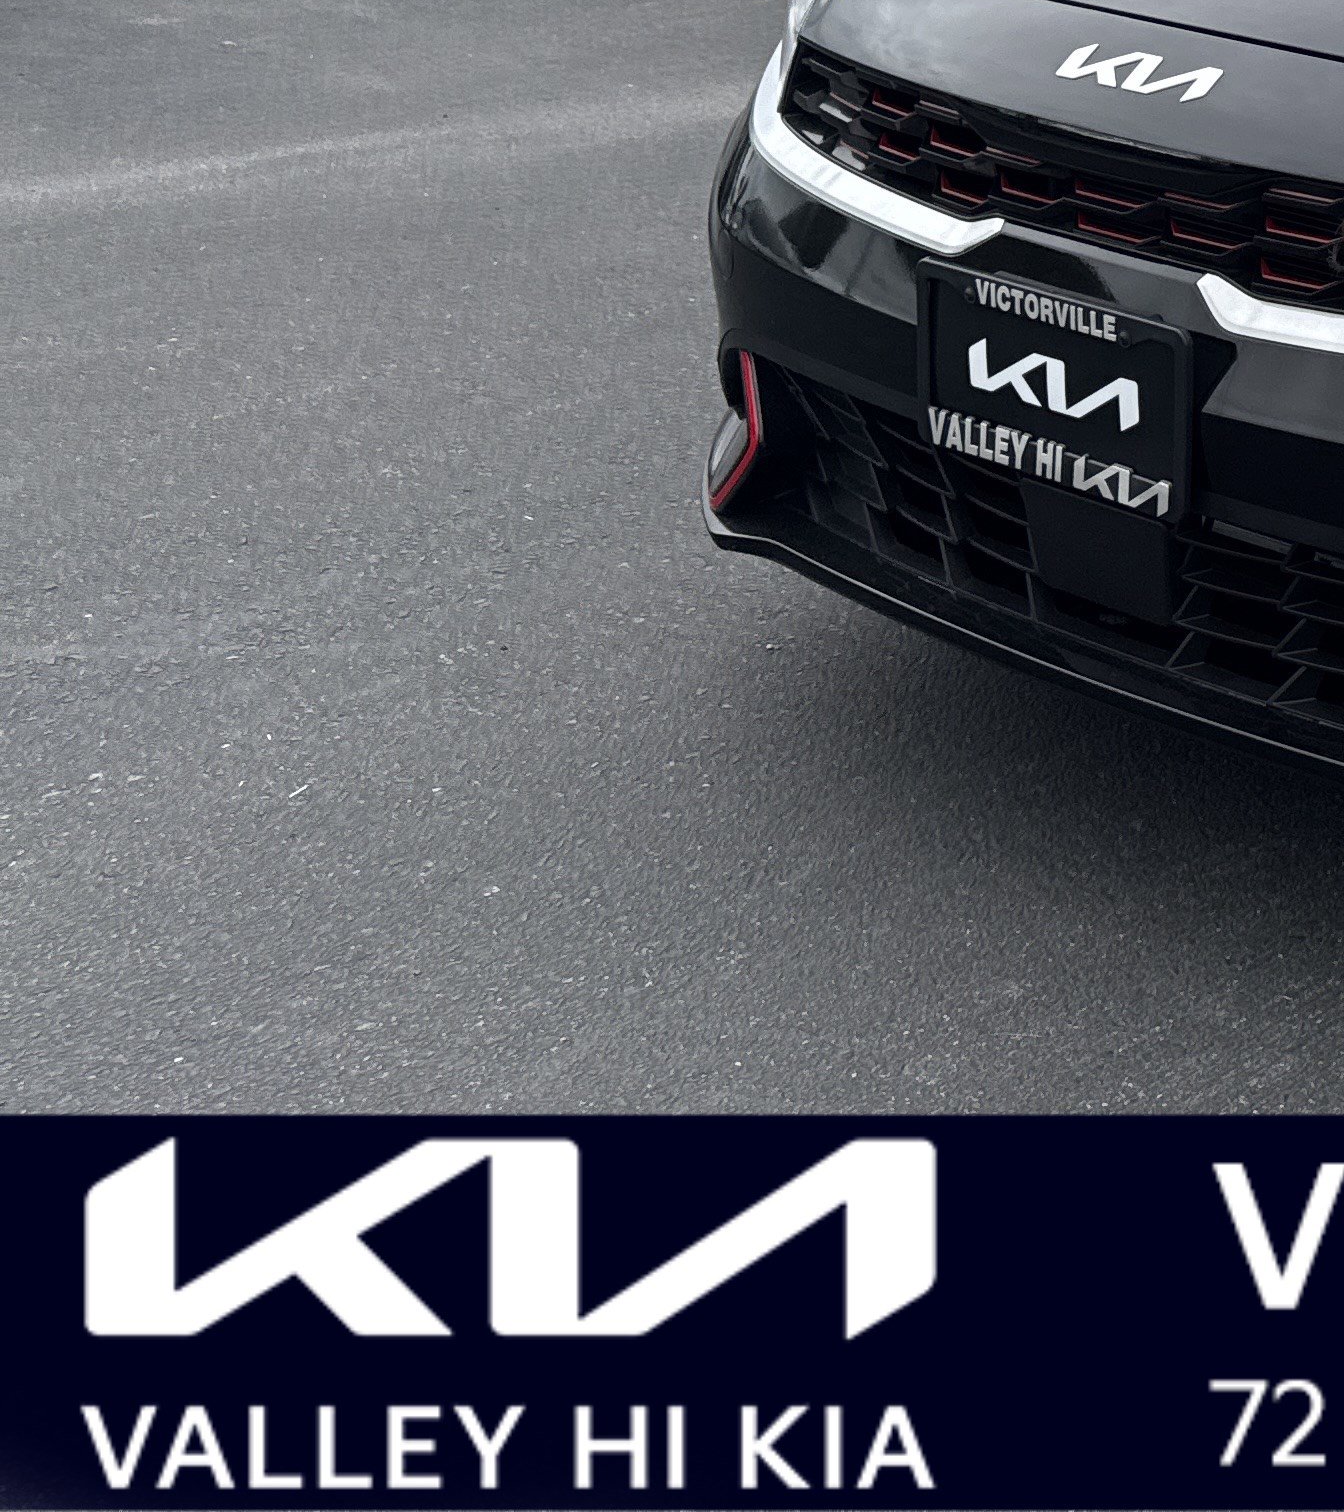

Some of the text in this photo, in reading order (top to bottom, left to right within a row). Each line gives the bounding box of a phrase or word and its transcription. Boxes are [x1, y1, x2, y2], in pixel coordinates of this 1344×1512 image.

[1055, 43, 1224, 103] KIA
[975, 278, 1117, 342] VICTORVILLE
[968, 337, 1140, 432] KIA
[928, 405, 1173, 518] VALLEY HI KIA
